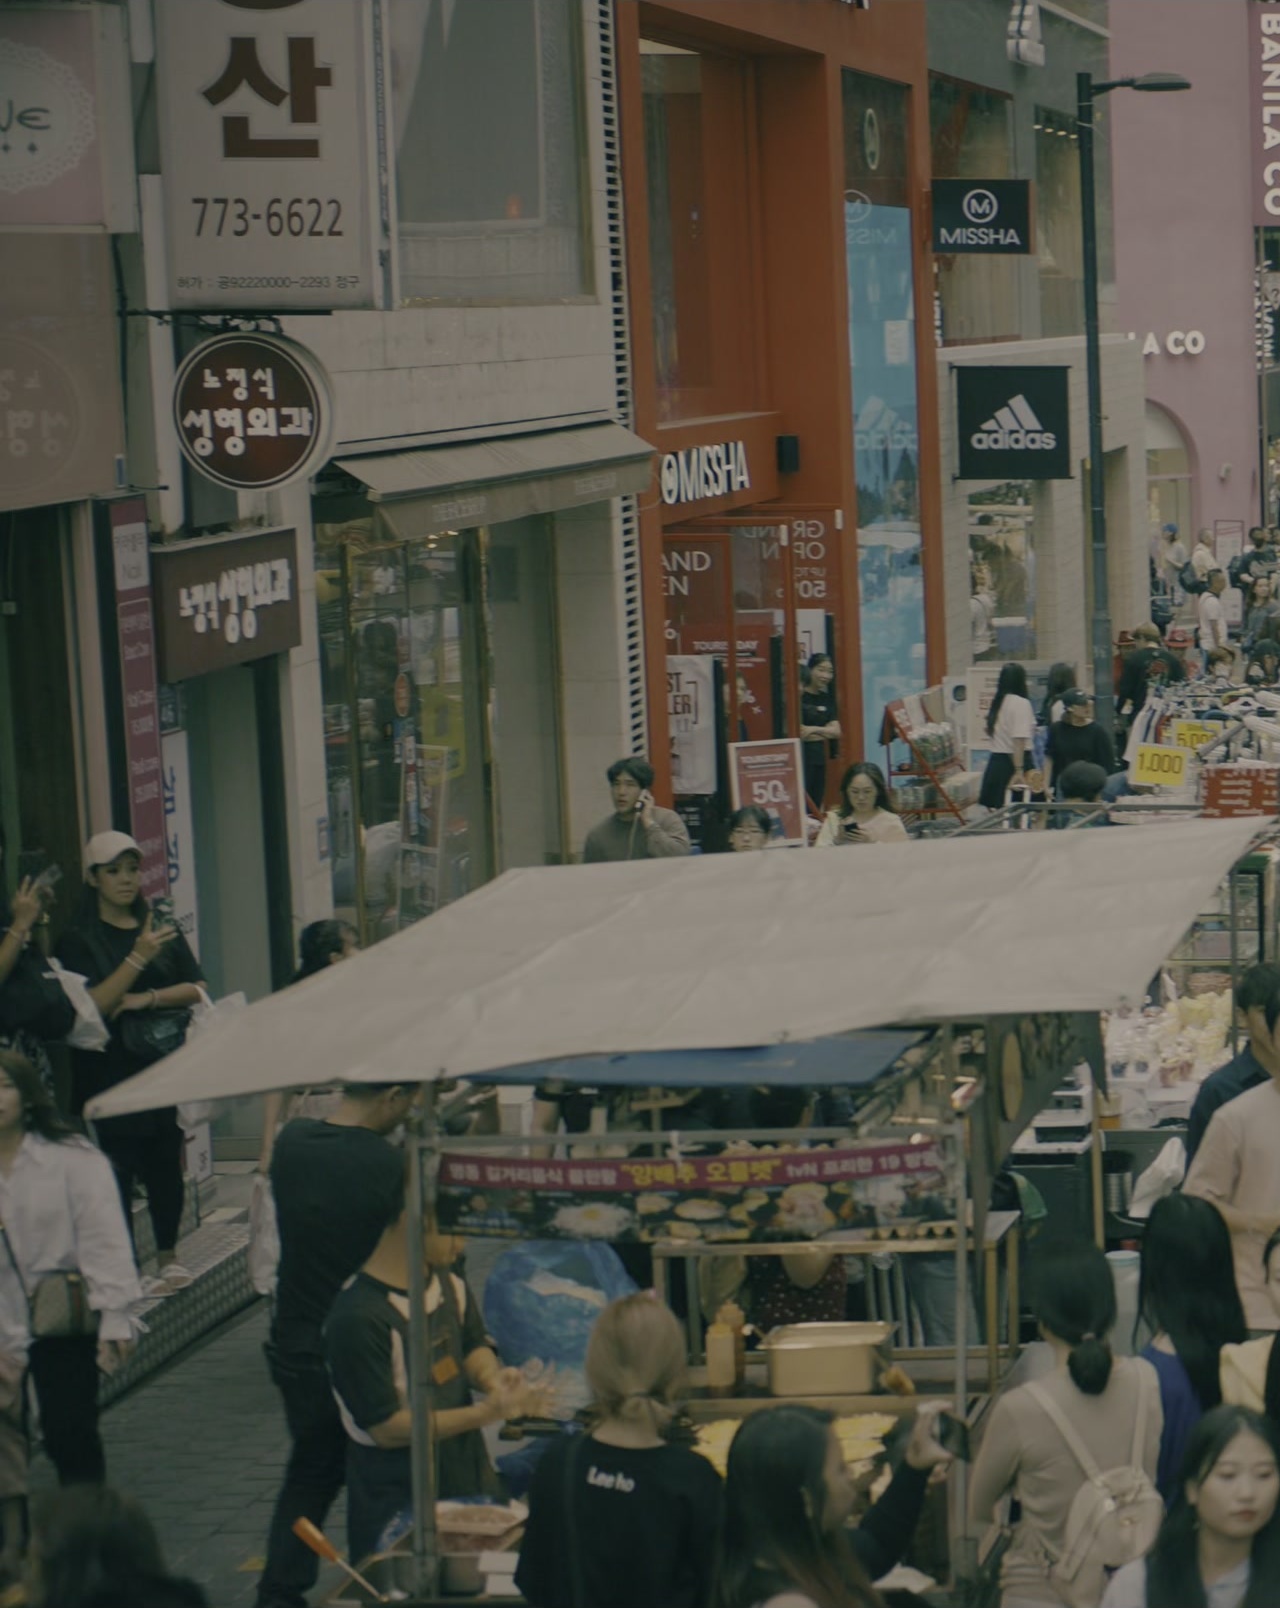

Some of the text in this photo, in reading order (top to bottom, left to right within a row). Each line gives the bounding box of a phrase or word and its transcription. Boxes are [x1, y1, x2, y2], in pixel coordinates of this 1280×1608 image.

[191, 197, 345, 237] 773-6622
[939, 227, 1022, 246] MISSHA
[1165, 329, 1207, 355] CO
[182, 406, 314, 458] 성형외과
[970, 427, 1057, 451] adidas
[678, 440, 751, 503] MISSHA
